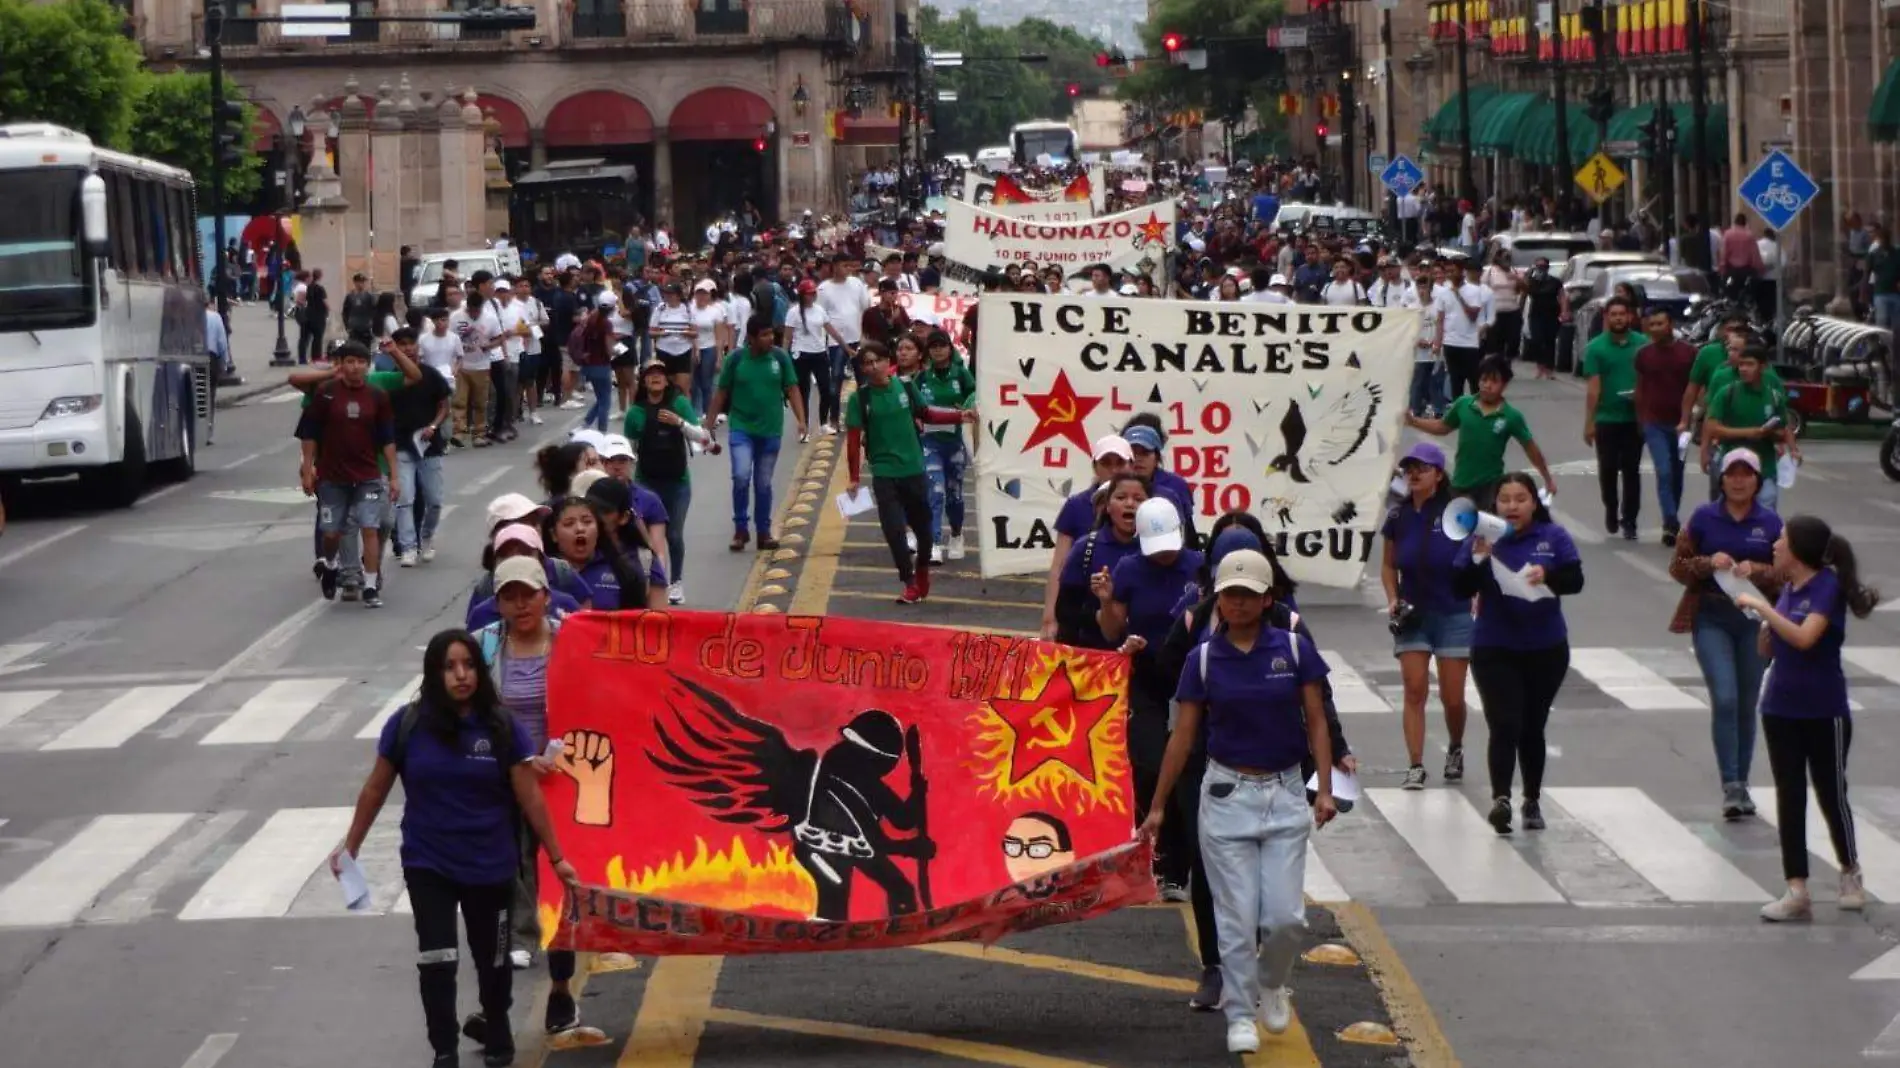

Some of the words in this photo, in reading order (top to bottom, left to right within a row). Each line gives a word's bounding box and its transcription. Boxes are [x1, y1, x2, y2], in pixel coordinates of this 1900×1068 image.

[1772, 162, 1785, 177] E
[973, 216, 1132, 241] HALCONAZO
[995, 250, 1009, 260] 10
[1015, 252, 1031, 261] DE
[1036, 251, 1077, 262] JUNIO
[1010, 302, 1142, 338] H.C.E.
[1185, 309, 1383, 337] BENITO
[1080, 341, 1330, 374] CANALES
[1111, 386, 1133, 411] L
[1168, 402, 1231, 434] 10
[1173, 445, 1230, 478] DE
[992, 516, 1055, 549] LA
[592, 611, 671, 664] 10
[701, 613, 765, 678] de
[780, 616, 929, 692] Junio
[949, 632, 1030, 701] 1971
